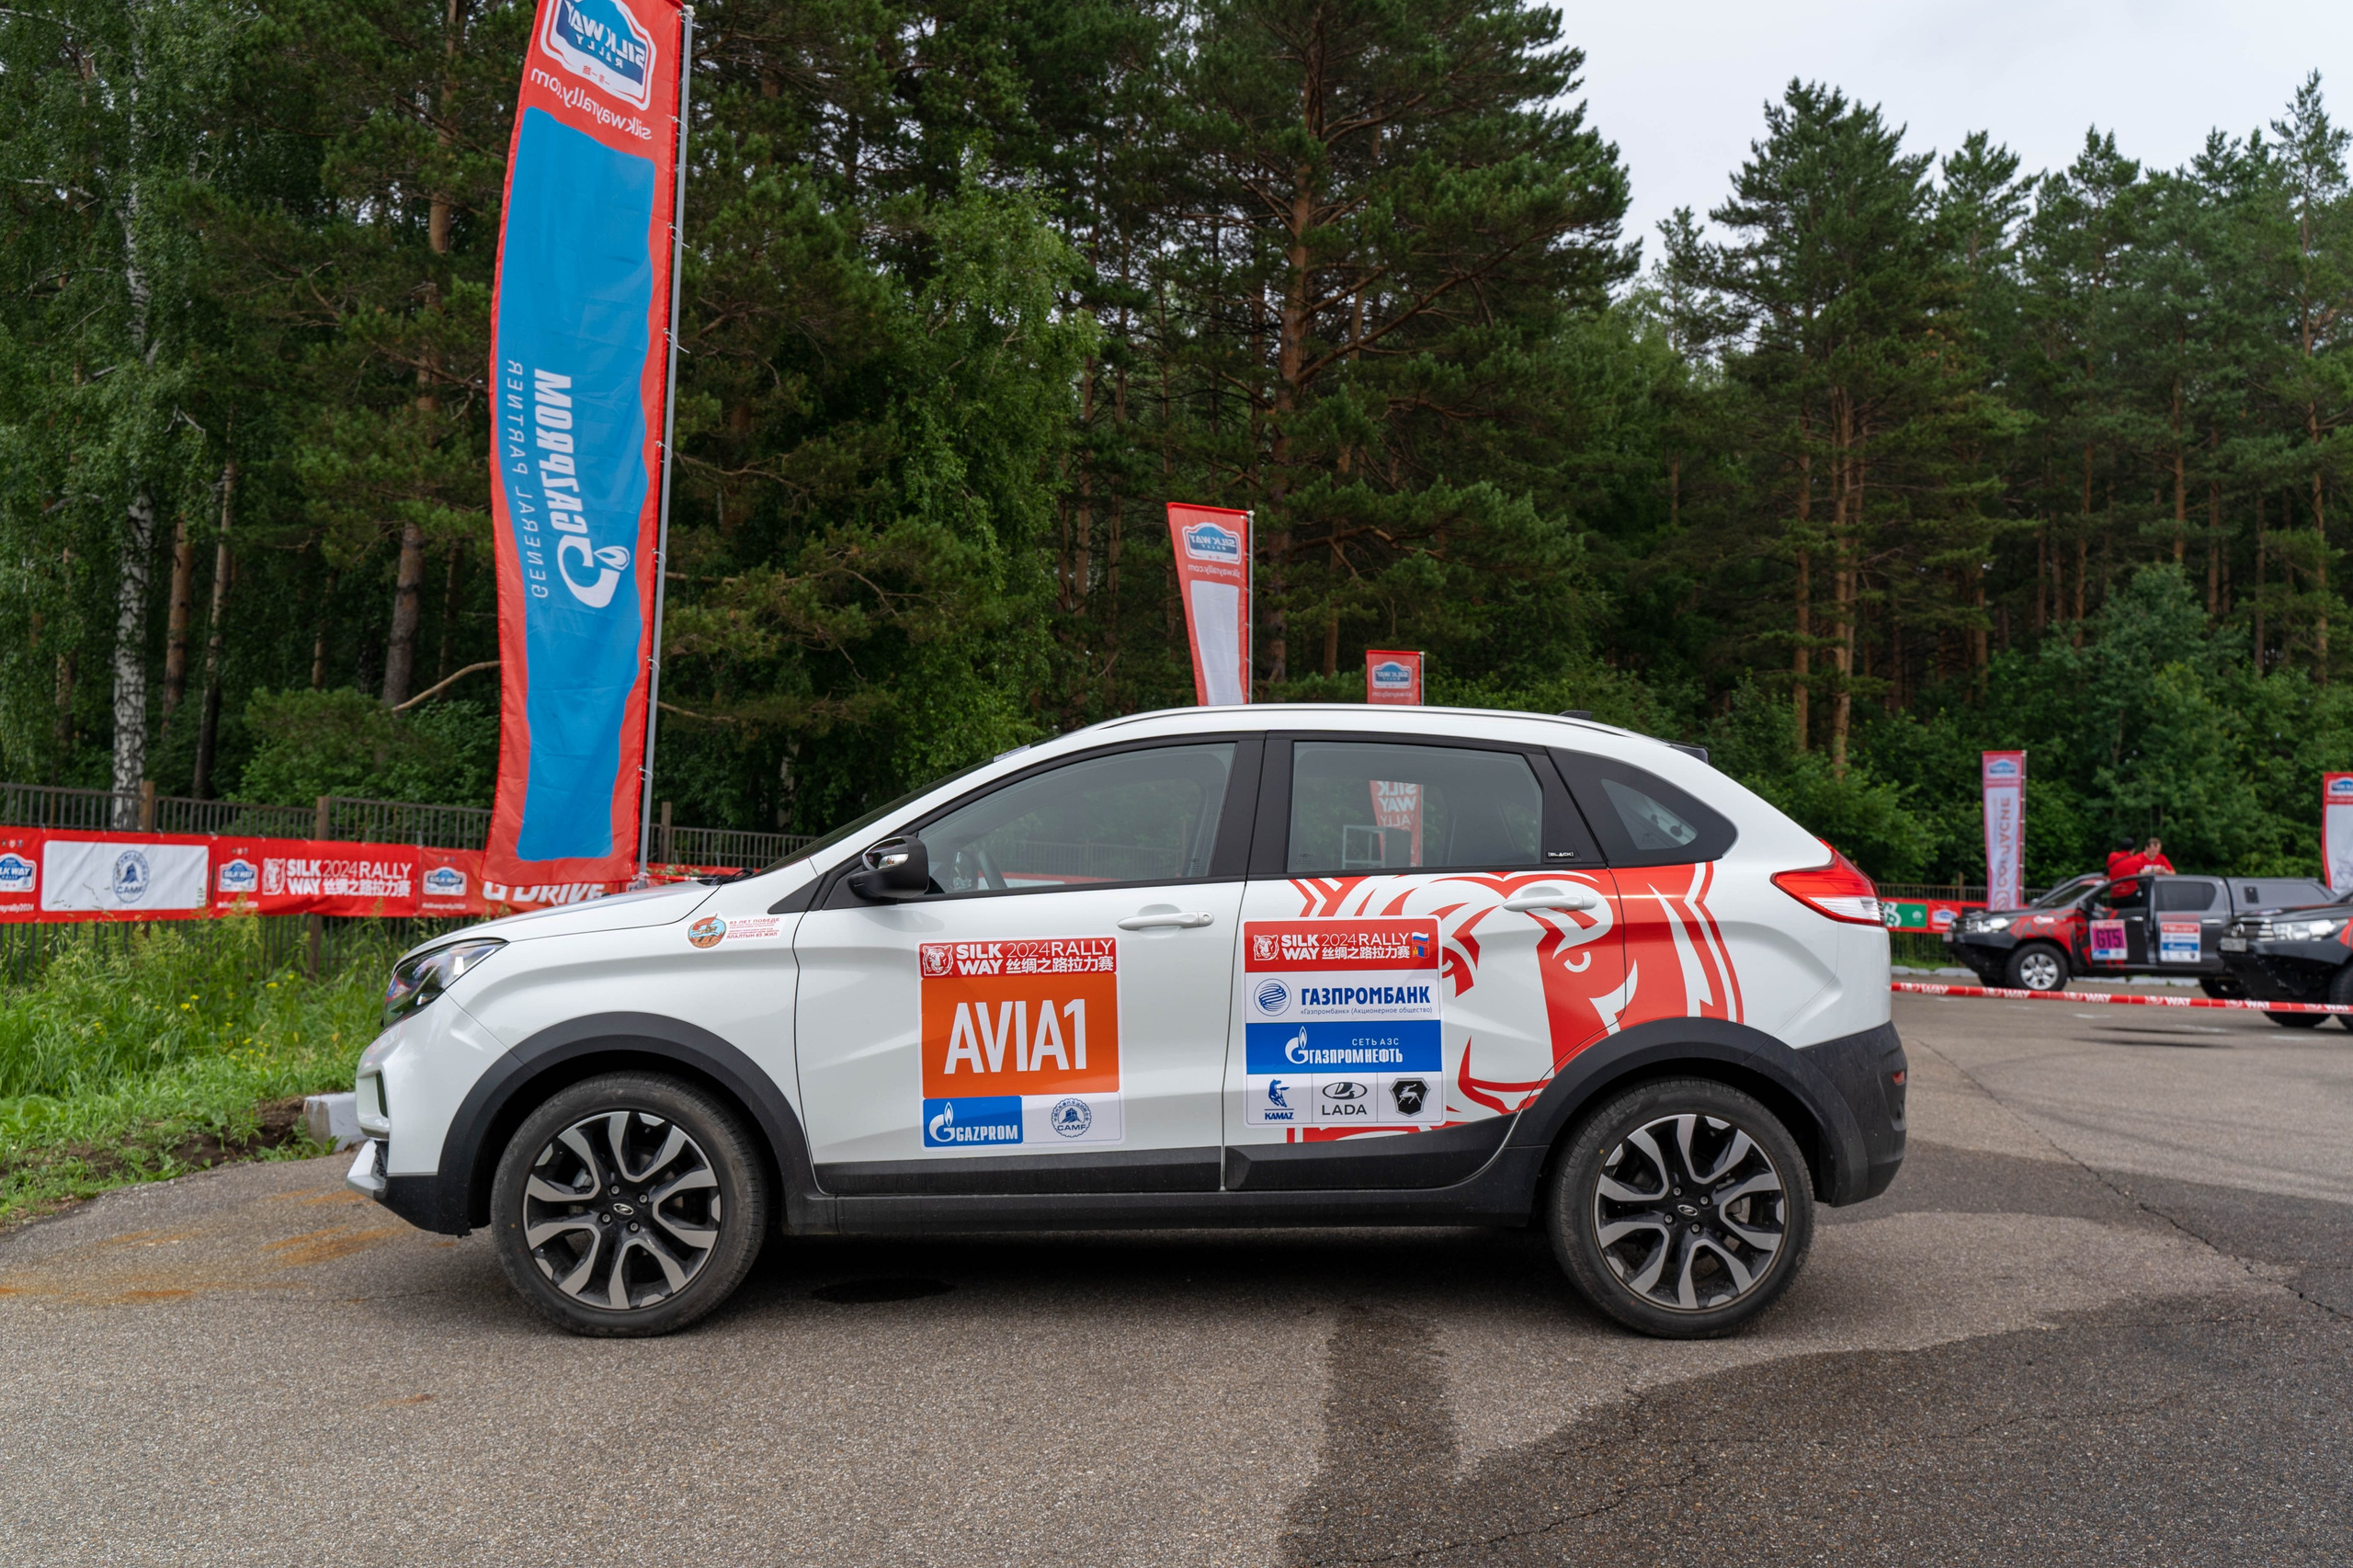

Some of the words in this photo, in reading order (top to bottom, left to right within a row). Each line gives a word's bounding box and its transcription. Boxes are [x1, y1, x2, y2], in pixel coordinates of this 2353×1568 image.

[11, 867, 30, 876] WAY
[287, 858, 322, 877] SILK
[323, 859, 358, 879] 2024
[358, 861, 412, 880] RALLY
[287, 878, 321, 895] WAY
[323, 880, 411, 897] 丝绸之路拉力赛
[1281, 934, 1320, 948] SILK
[1322, 933, 1357, 947] 2024
[1358, 932, 1410, 946] RALLY
[2097, 929, 2121, 949] GT5
[956, 943, 1004, 960] SILK
[1006, 942, 1051, 959] 2024
[1051, 939, 1113, 956] RALLY
[1282, 947, 1318, 960] WAY
[1322, 946, 1410, 960] 丝绸之路拉力赛
[957, 959, 1002, 975] WAY
[1006, 956, 1114, 974] 丝绸之路拉力赛
[1302, 986, 1431, 1006] ГАЗПРОМБАНК
[2003, 988, 2030, 999] WAY
[2084, 993, 2111, 1003] WAY
[2165, 996, 2191, 1006] WAY
[1301, 1007, 1350, 1016] «Газпромбанк»
[1351, 1006, 1397, 1015] (Акционерное
[1399, 1006, 1433, 1014] общество)
[944, 998, 1087, 1074] AVIA1
[1352, 1038, 1377, 1046] СЕТЬ
[1380, 1038, 1399, 1046] АЗС
[1309, 1048, 1404, 1064] ГАЗПРОМНЕФТЬ
[1265, 1111, 1294, 1120] KAMAZ
[1322, 1104, 1368, 1116] LADA
[956, 1125, 1018, 1142] GAZPROM
[1057, 1123, 1086, 1131] CAMF
